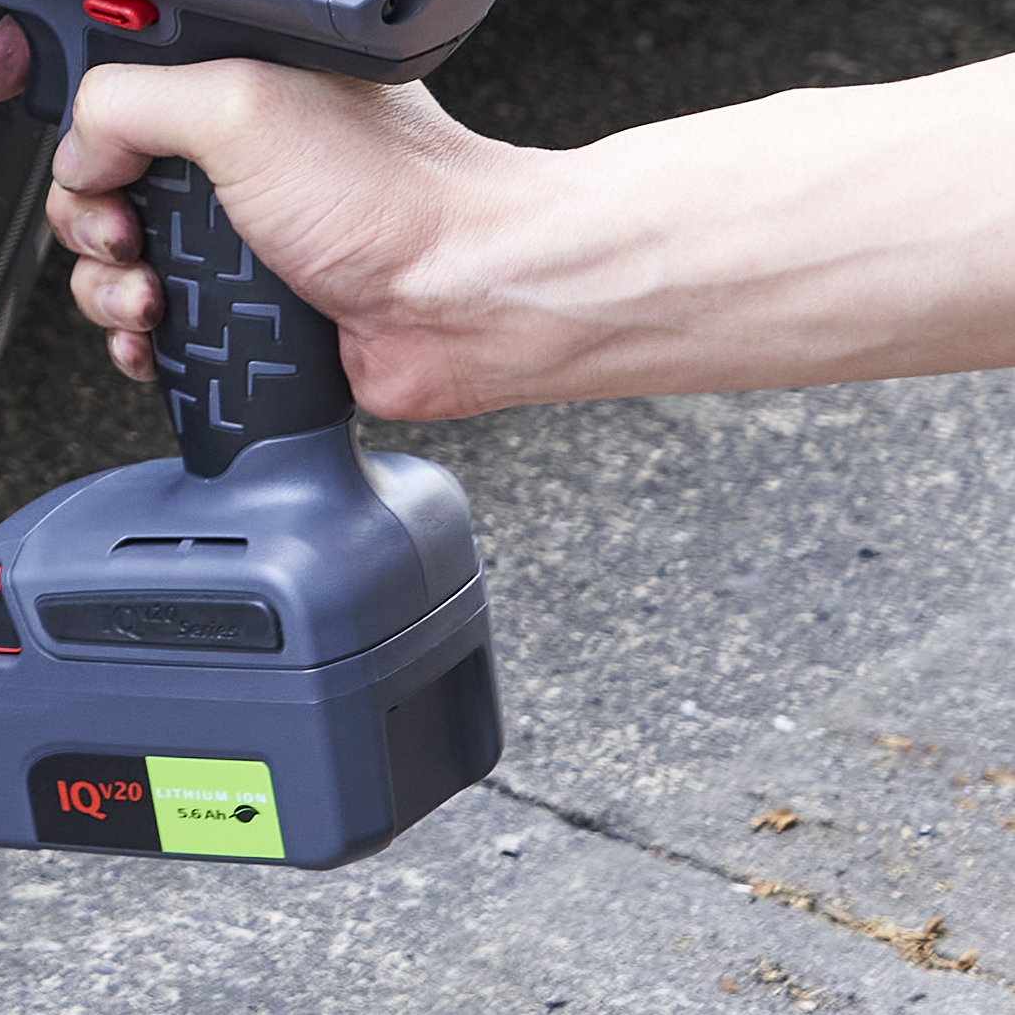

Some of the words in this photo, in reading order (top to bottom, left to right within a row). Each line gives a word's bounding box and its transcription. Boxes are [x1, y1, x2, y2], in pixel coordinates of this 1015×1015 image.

[155, 788, 229, 802] LITHIUM
[236, 792, 267, 804] ION
[177, 808, 201, 820] 5.6
[204, 809, 226, 820] Ah
